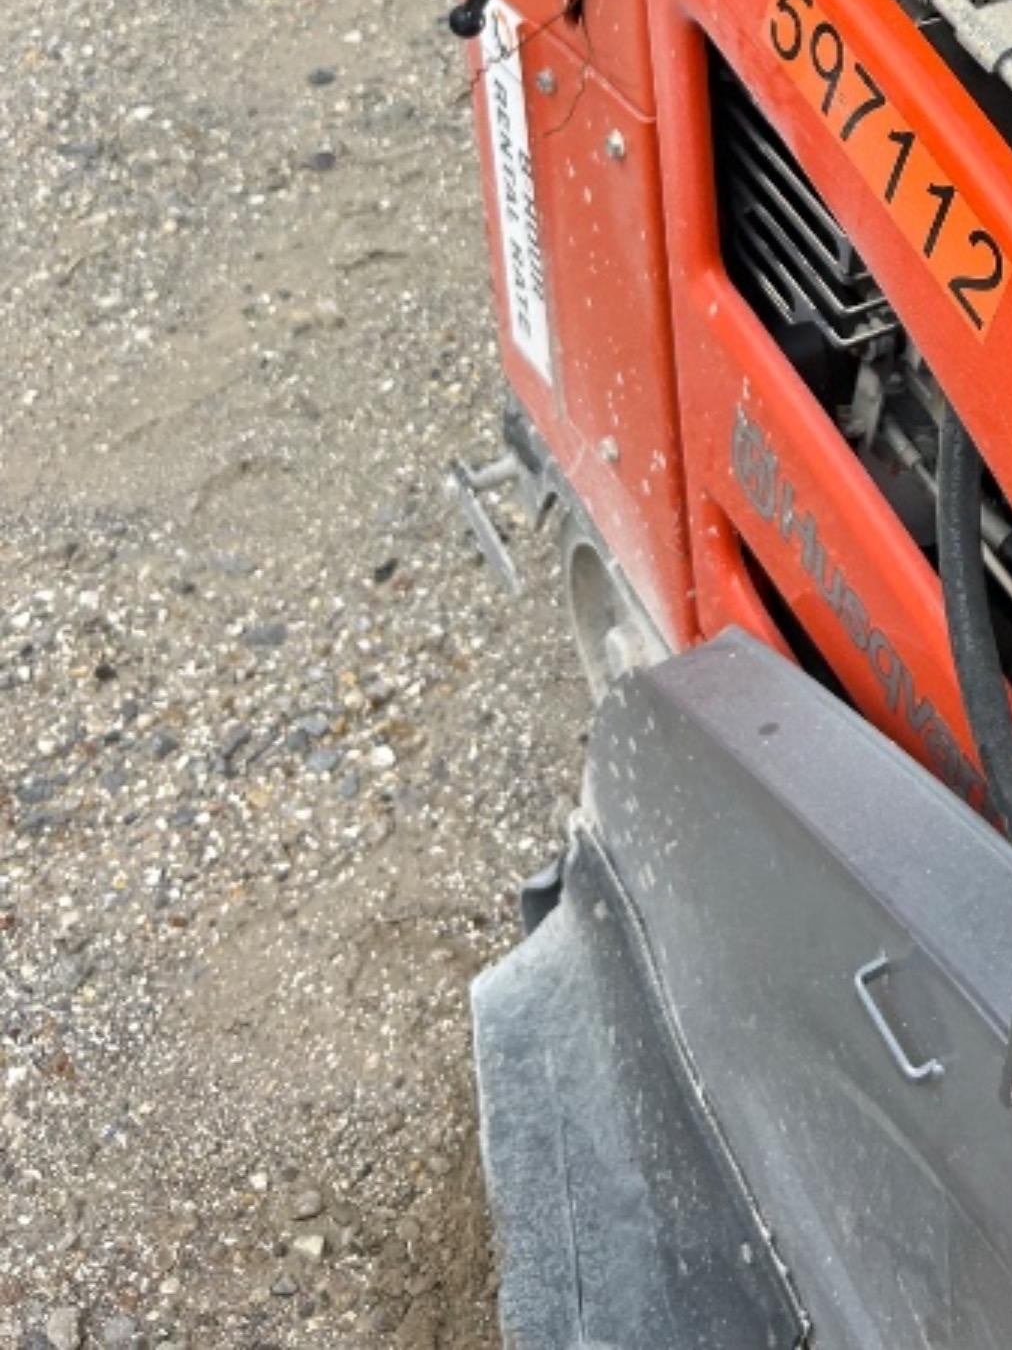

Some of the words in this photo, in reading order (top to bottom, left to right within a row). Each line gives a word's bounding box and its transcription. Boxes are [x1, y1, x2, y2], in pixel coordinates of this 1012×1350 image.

[494, 77, 520, 222] RENTAL
[510, 236, 533, 340] RATE
[778, 478, 995, 815] Husqvar
